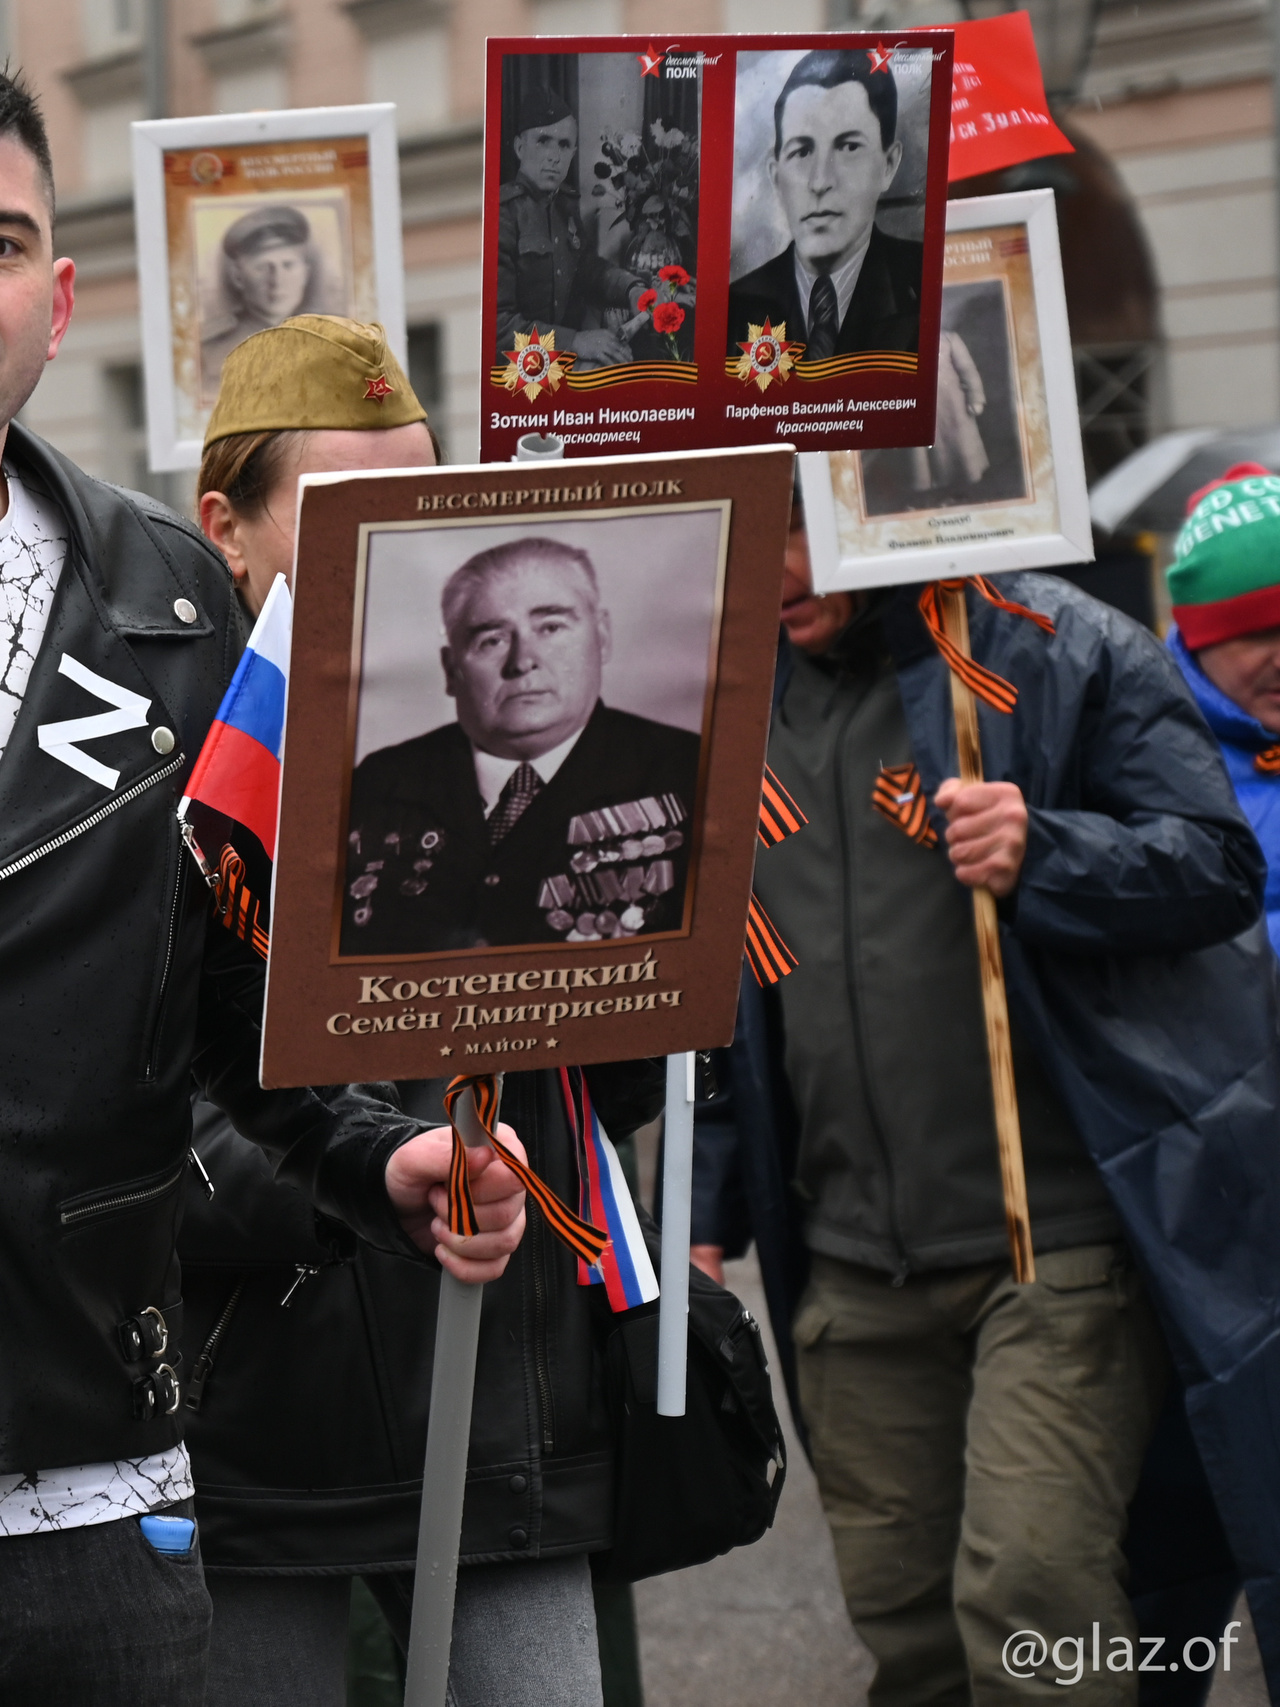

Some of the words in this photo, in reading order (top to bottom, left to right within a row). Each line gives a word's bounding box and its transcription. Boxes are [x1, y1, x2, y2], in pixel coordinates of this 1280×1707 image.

[666, 67, 697, 79] ПОЛК
[894, 63, 922, 75] ПОЛК
[491, 410, 549, 429] Зоткин
[553, 409, 595, 427] Иван
[598, 405, 696, 424] Николаевич
[725, 404, 790, 420] Парфенов
[792, 398, 845, 415] Василий
[847, 396, 918, 412] Алексеевич
[776, 416, 864, 435] Красноармеец
[417, 480, 602, 512] БЕССМЕРТНЫЙ
[612, 479, 683, 500] ПОЛК
[935, 528, 1015, 544] Владимирович
[357, 948, 660, 1005] Костенецкий
[326, 1007, 442, 1036] Семён
[451, 989, 683, 1033] Дмитриевич
[464, 1037, 538, 1056] МАЙОР
